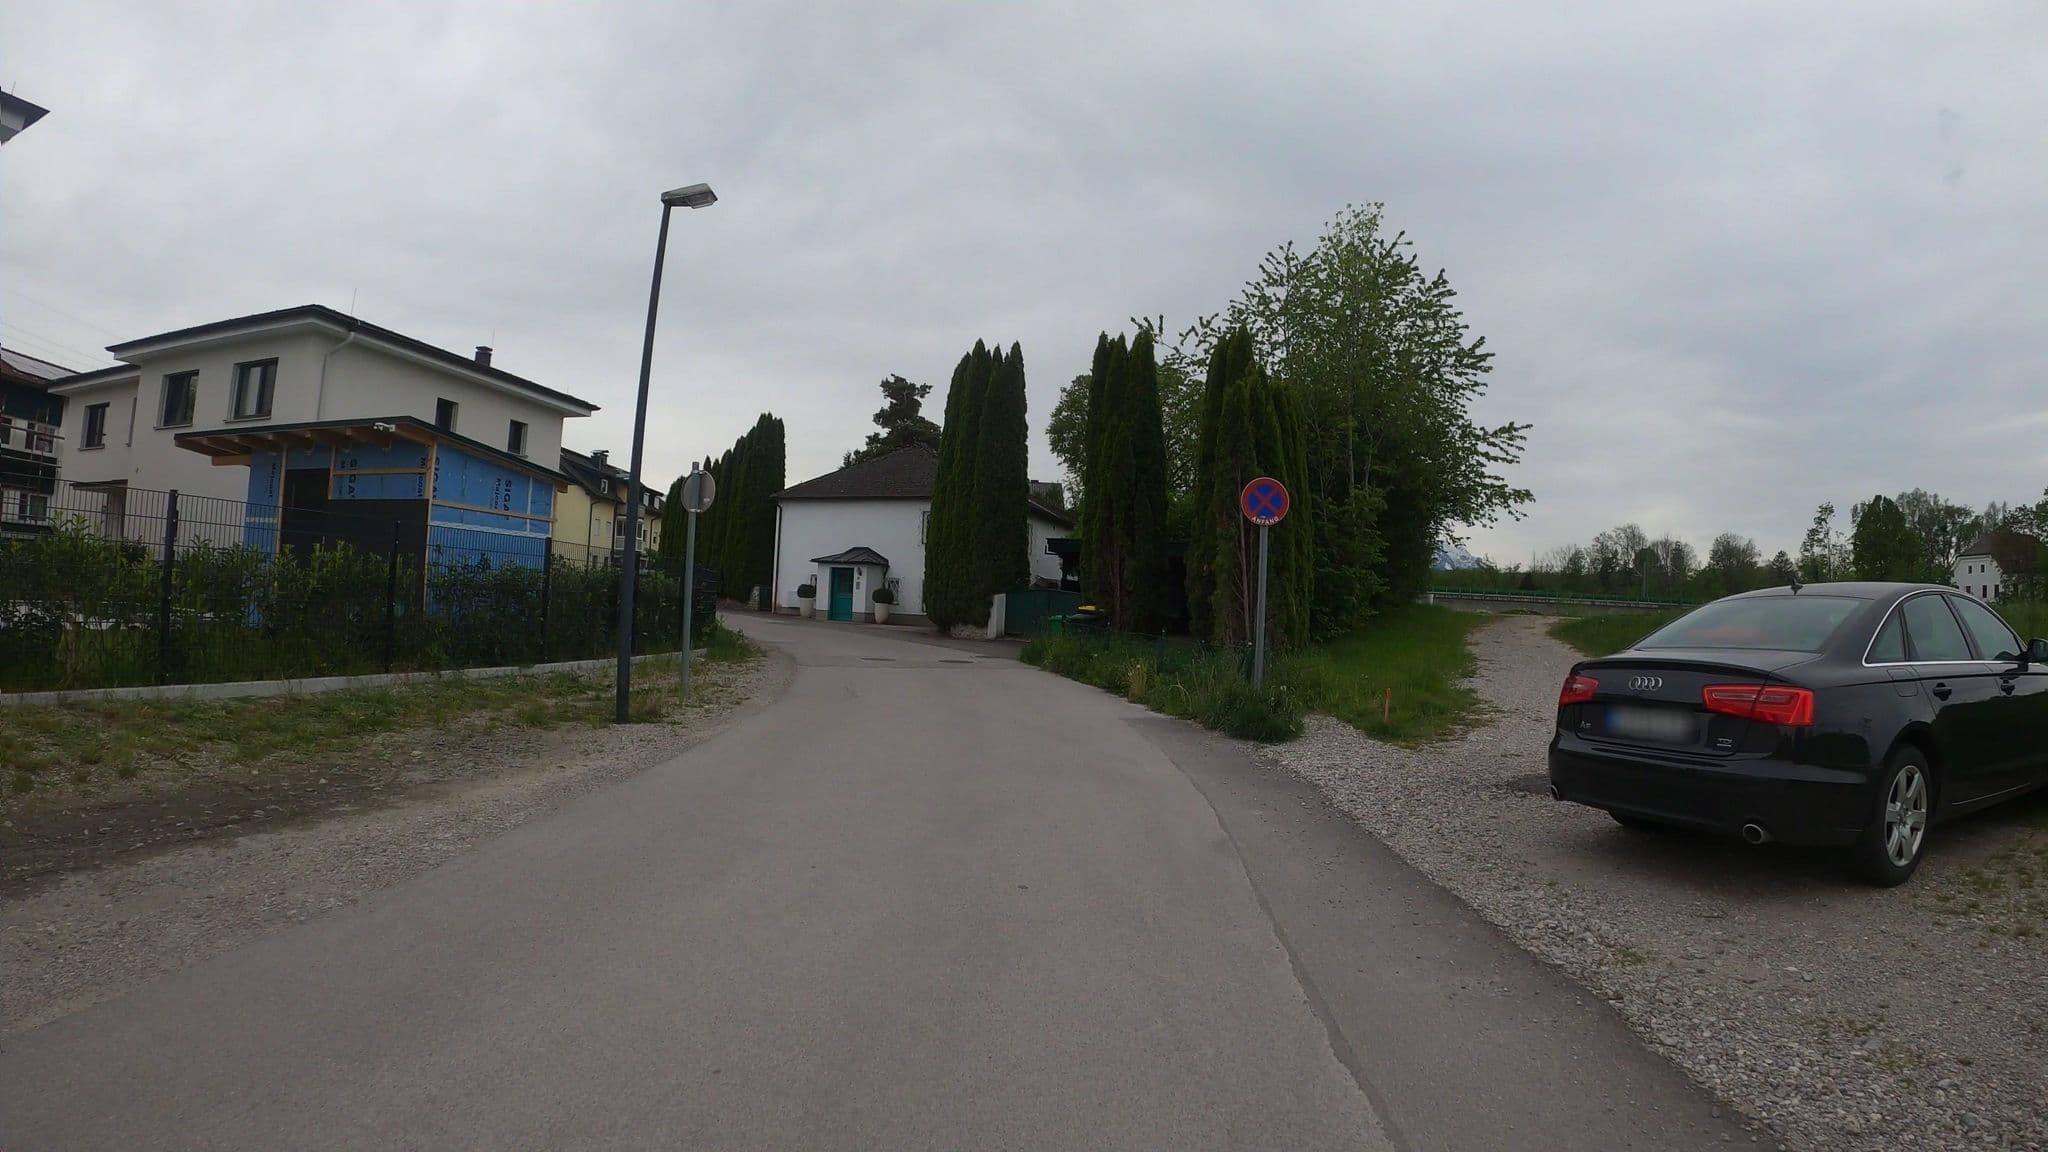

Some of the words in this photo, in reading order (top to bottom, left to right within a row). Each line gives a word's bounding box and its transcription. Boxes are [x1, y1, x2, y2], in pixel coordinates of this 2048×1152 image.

[347, 458, 358, 494] SGA
[503, 479, 512, 511] SIGA
[1251, 515, 1278, 526] ANFANG
